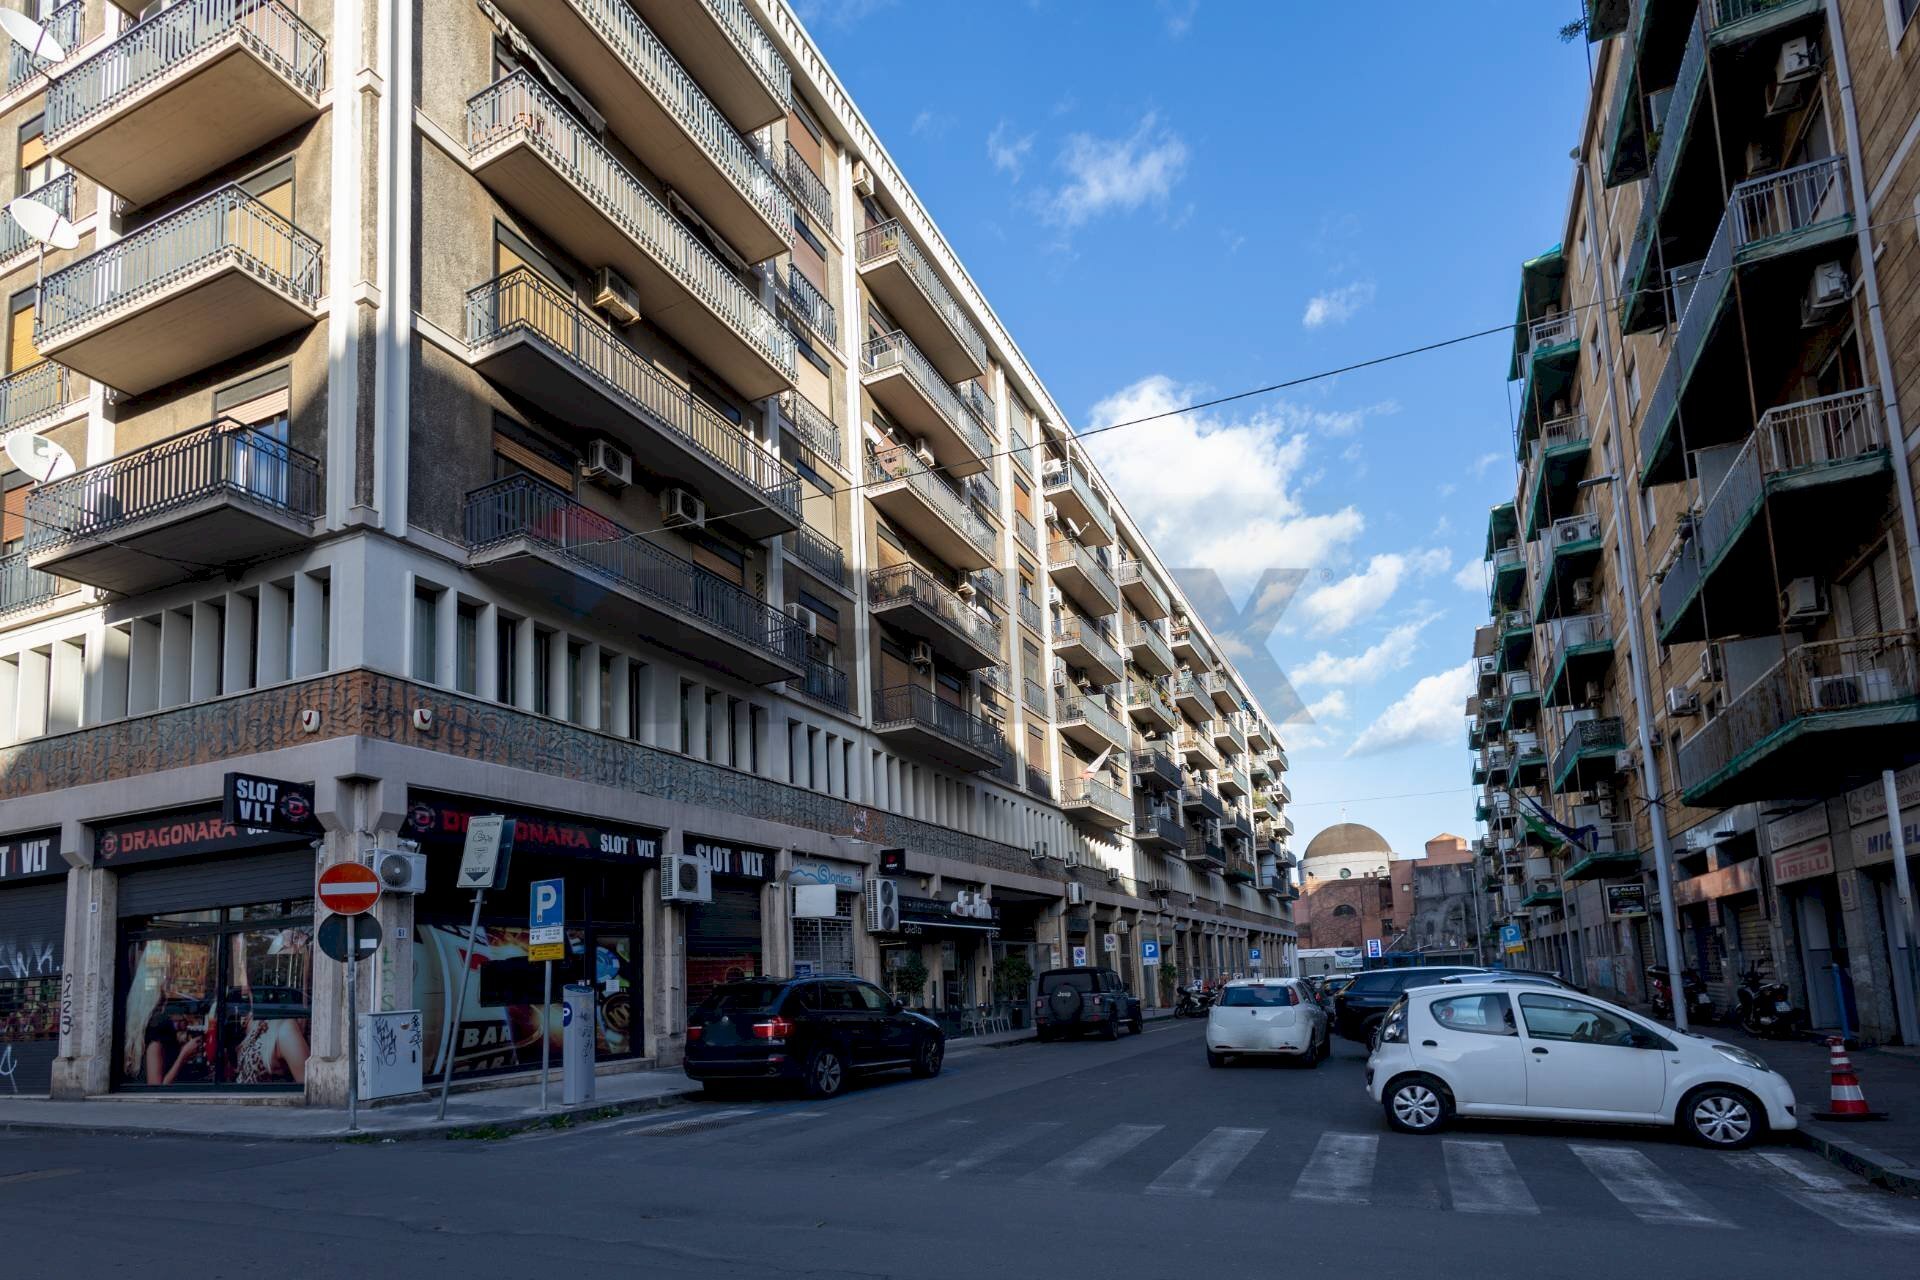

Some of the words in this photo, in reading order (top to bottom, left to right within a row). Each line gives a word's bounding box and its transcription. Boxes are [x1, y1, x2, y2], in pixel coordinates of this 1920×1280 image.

[236, 779, 278, 802] SLOT
[239, 800, 275, 823] VLT
[121, 818, 237, 852] DRAGONARA
[443, 809, 591, 849] DONARA
[600, 832, 629, 855] SLOT
[636, 838, 656, 858] VLT
[1867, 820, 1920, 855] MICEL
[22, 839, 50, 873] VLT
[741, 850, 765, 877] VLT
[1775, 842, 1830, 880] PIRELLI
[536, 884, 557, 923] P
[1505, 928, 1516, 940] P
[1145, 944, 1155, 957] P
[1252, 950, 1259, 959] P
